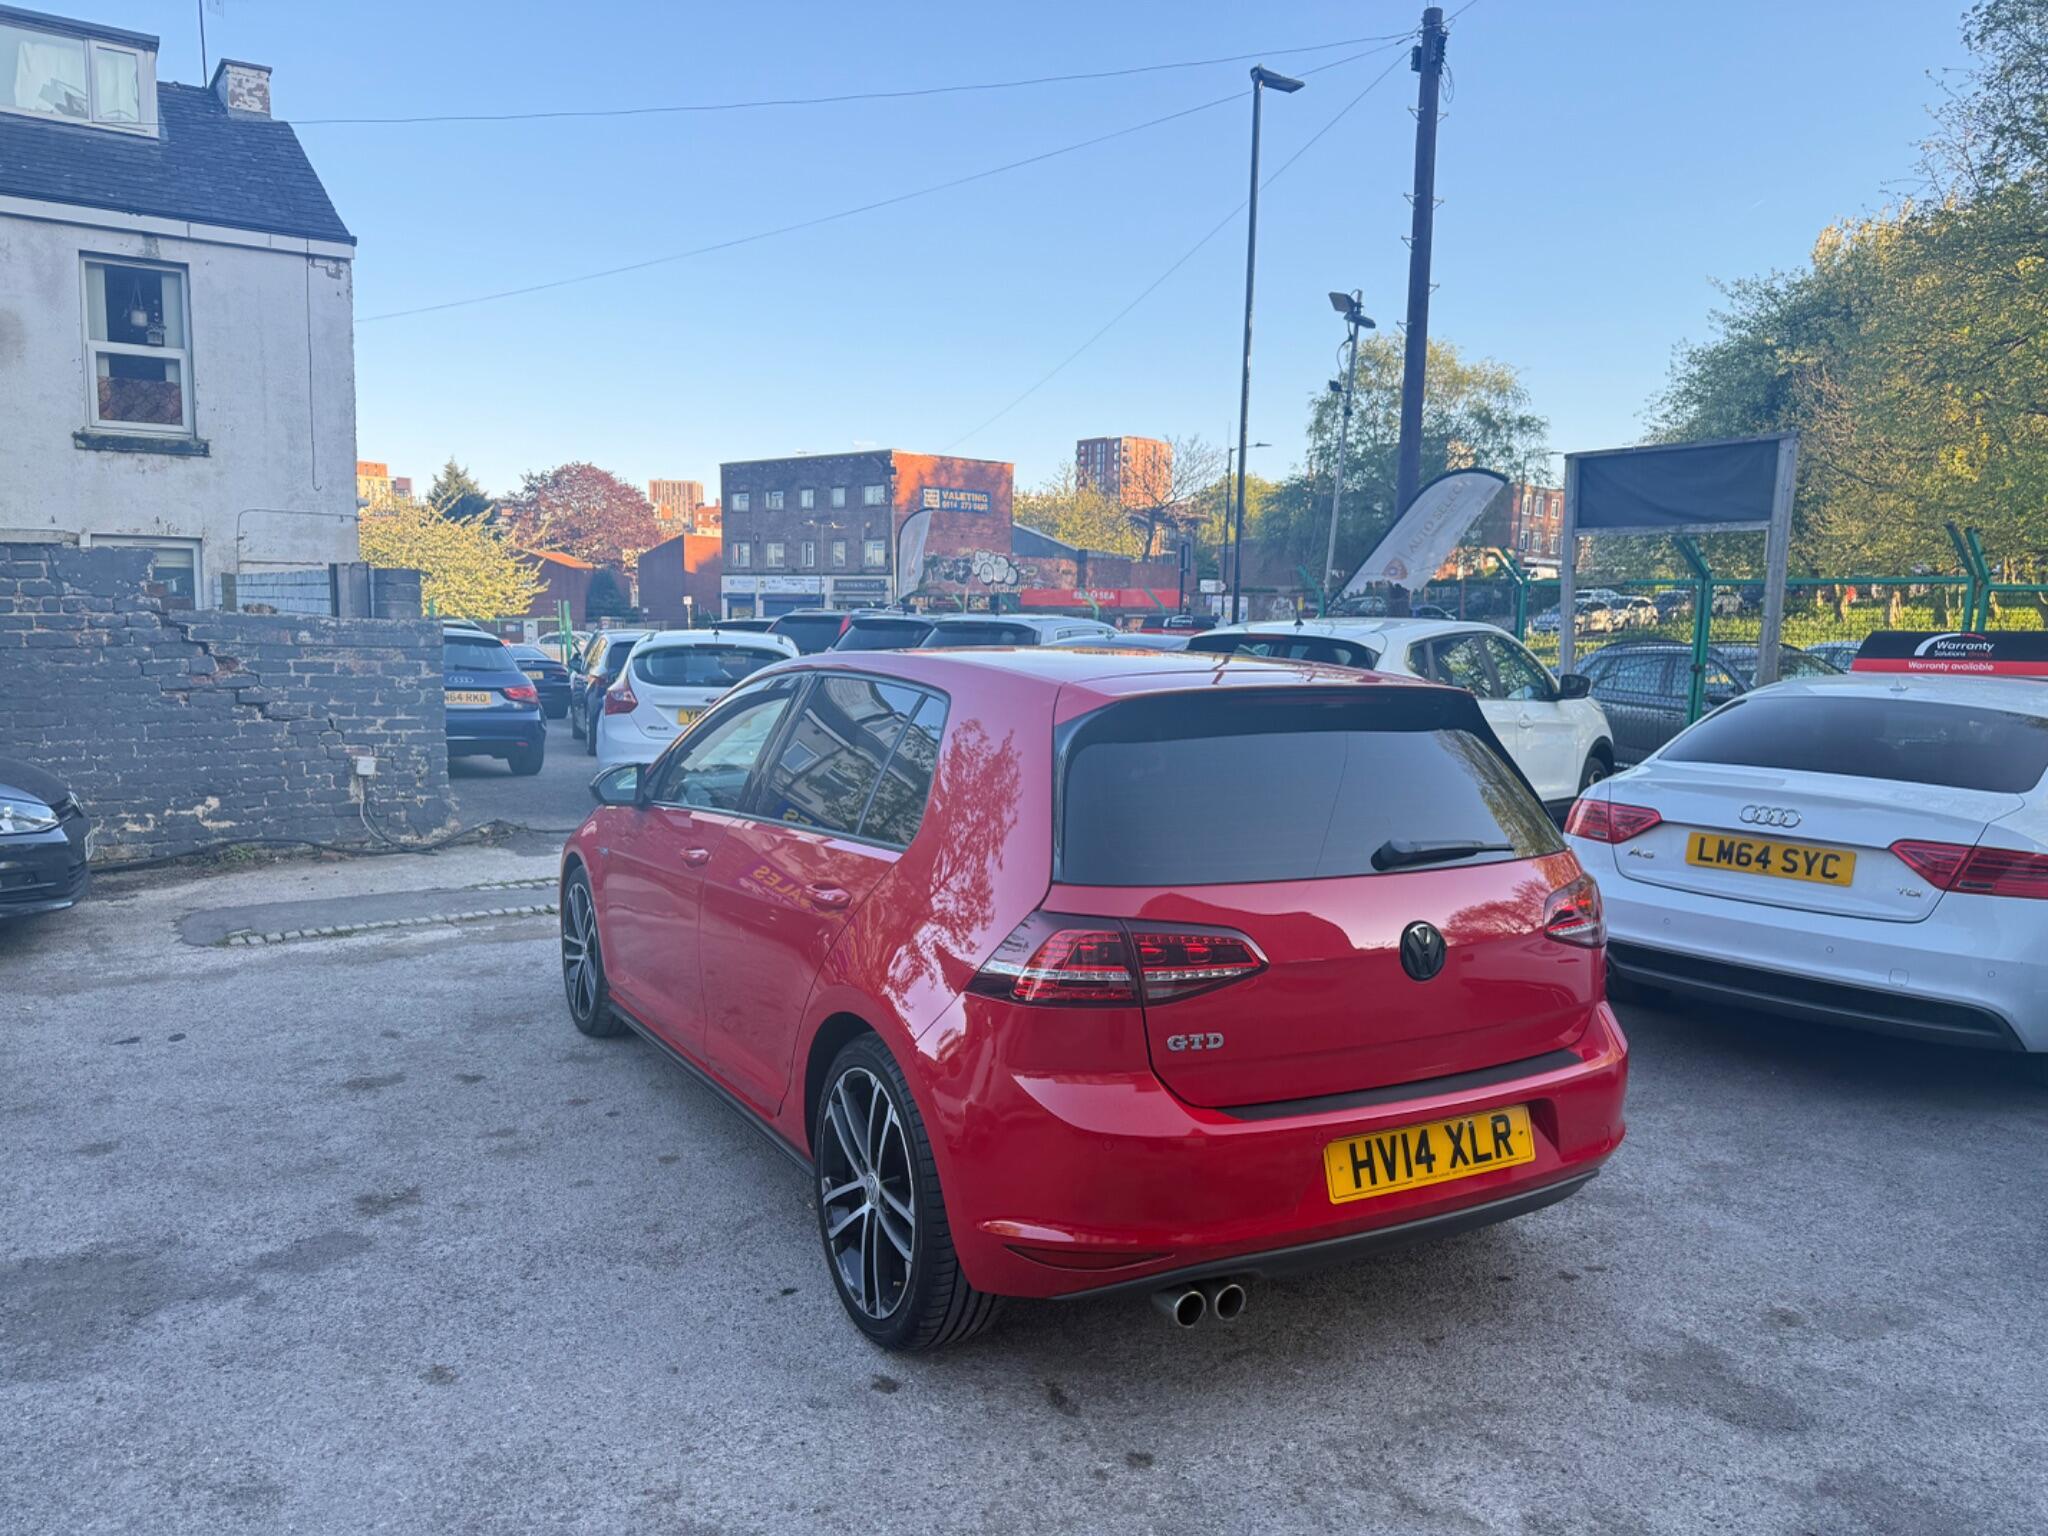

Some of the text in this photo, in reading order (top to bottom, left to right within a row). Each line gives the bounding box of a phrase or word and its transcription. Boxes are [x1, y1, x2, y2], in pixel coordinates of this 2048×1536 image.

[942, 491, 988, 502] VALETING
[1409, 520, 1434, 553] AUTO
[1937, 641, 1994, 652] Warranty
[1908, 661, 1994, 672] Warranty available
[1697, 837, 1841, 880] LM64 SYC
[1167, 1033, 1224, 1052] GTD
[1349, 1114, 1514, 1189] HV14 XLR
